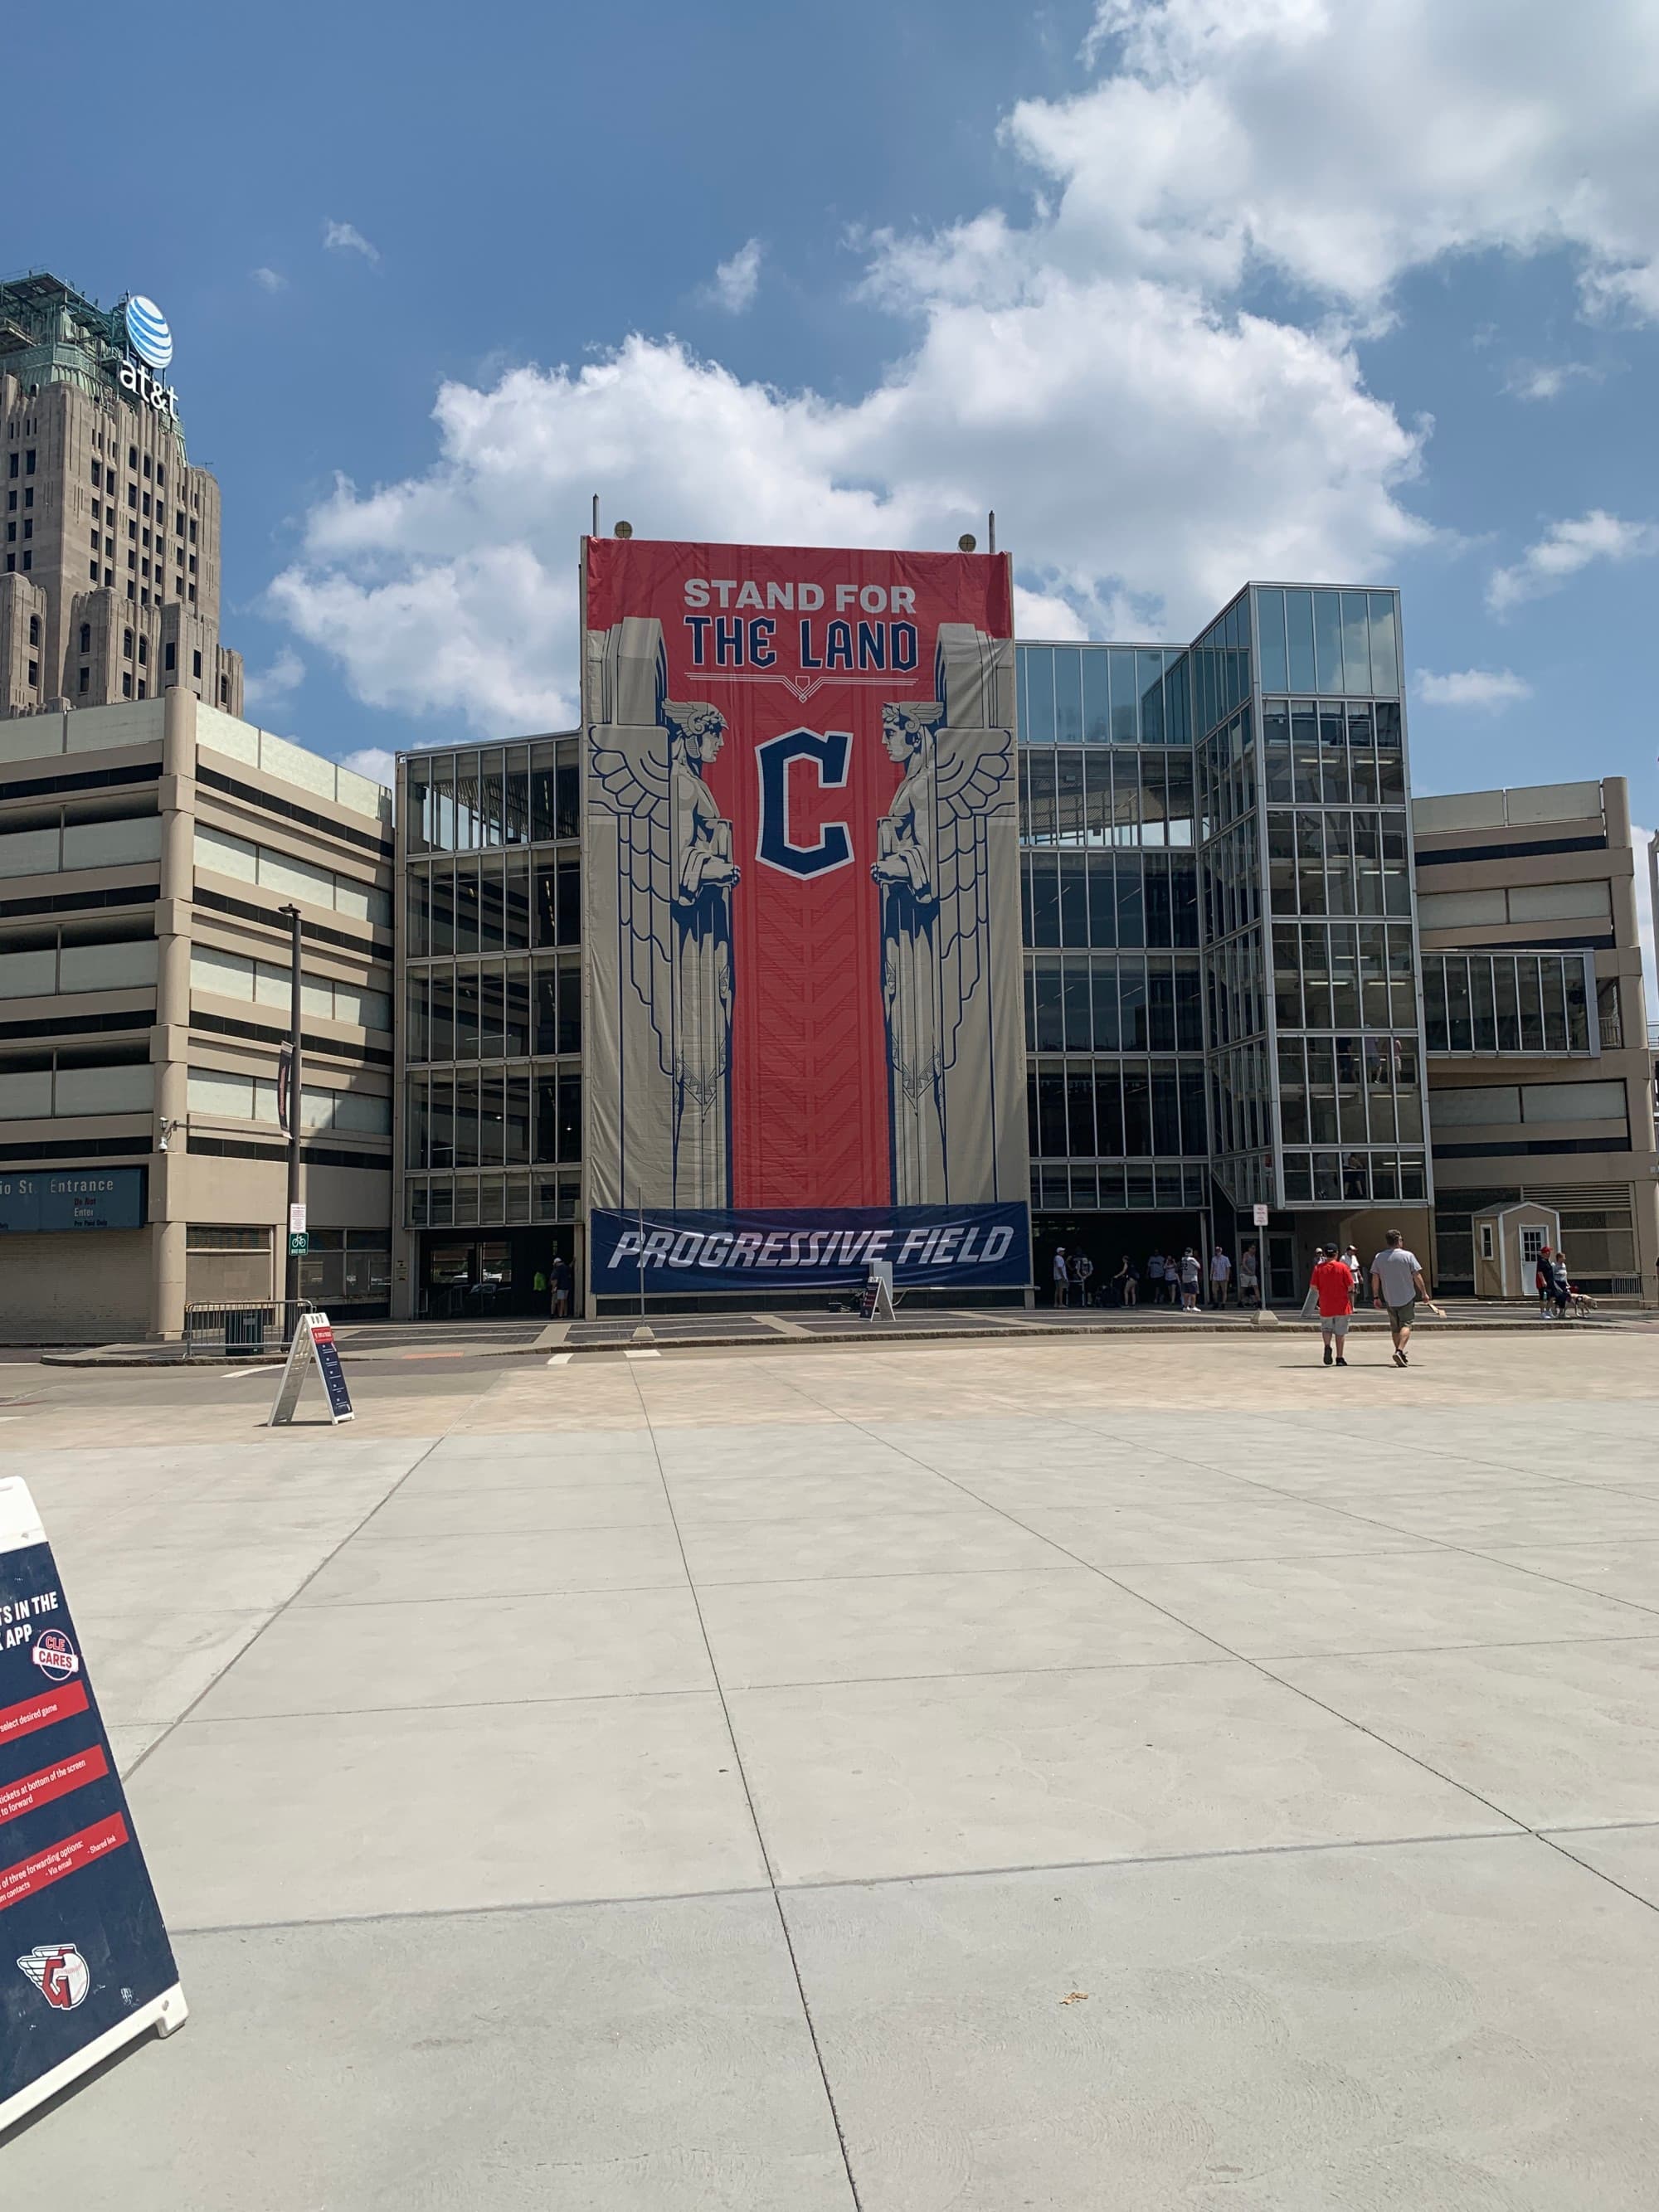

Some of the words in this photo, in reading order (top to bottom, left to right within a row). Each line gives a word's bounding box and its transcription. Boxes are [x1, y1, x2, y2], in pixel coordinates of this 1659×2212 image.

[120, 360, 179, 422] at&t
[684, 578, 825, 611] STAND
[835, 584, 917, 614] FOR
[684, 615, 776, 669] THE
[800, 618, 918, 673] LAND
[755, 727, 855, 881] C
[51, 1179, 114, 1193] Entrance
[607, 1229, 893, 1269] PROGRESSIVE
[896, 1225, 1014, 1265] FIELD
[14, 1600, 30, 1621] IN
[32, 1592, 58, 1615] THE
[7, 1624, 32, 1649] APP
[46, 1636, 66, 1652] CLE
[39, 1651, 72, 1669] CARES
[0, 1719, 18, 1733] select
[19, 1709, 41, 1725] desired
[41, 1704, 58, 1718] game
[21, 1785, 27, 1795] at
[27, 1776, 50, 1791] bottom
[50, 1772, 56, 1782] of
[56, 1768, 67, 1778] the
[66, 1760, 86, 1774] screen
[1, 1807, 8, 1816] to
[8, 1793, 33, 1812] forward
[89, 1841, 107, 1854] Shared
[106, 1835, 116, 1845] link
[2, 1876, 9, 1888] of
[9, 1870, 27, 1884] three
[27, 1852, 61, 1875] forwarding
[60, 1840, 84, 1858] options:
[48, 1866, 58, 1876] Via
[58, 1858, 72, 1871] email
[7, 1882, 31, 1898] contacts
